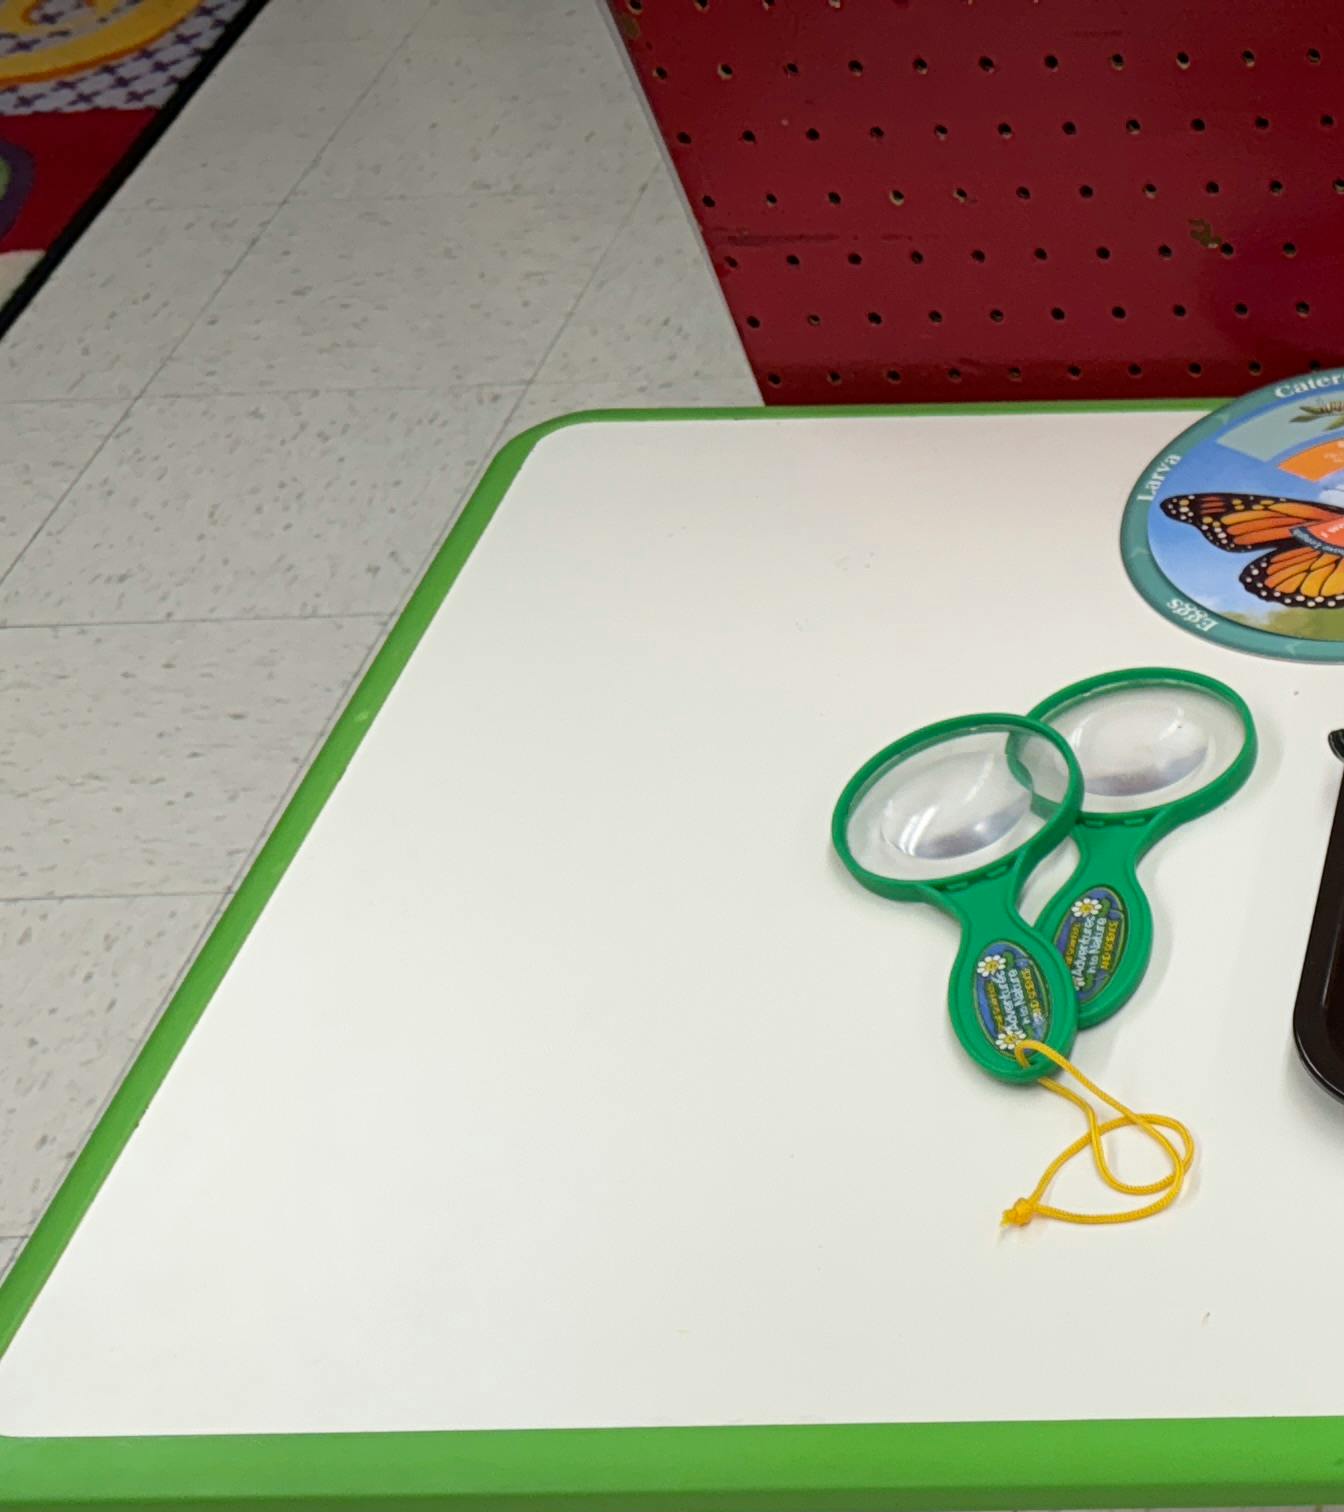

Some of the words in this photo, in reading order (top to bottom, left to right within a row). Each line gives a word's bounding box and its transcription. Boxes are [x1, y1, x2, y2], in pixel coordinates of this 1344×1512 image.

[1137, 454, 1182, 501] Larva
[1166, 598, 1218, 631] Eggs
[1072, 915, 1097, 976] Adventures
[995, 969, 1019, 1031] Adventures
